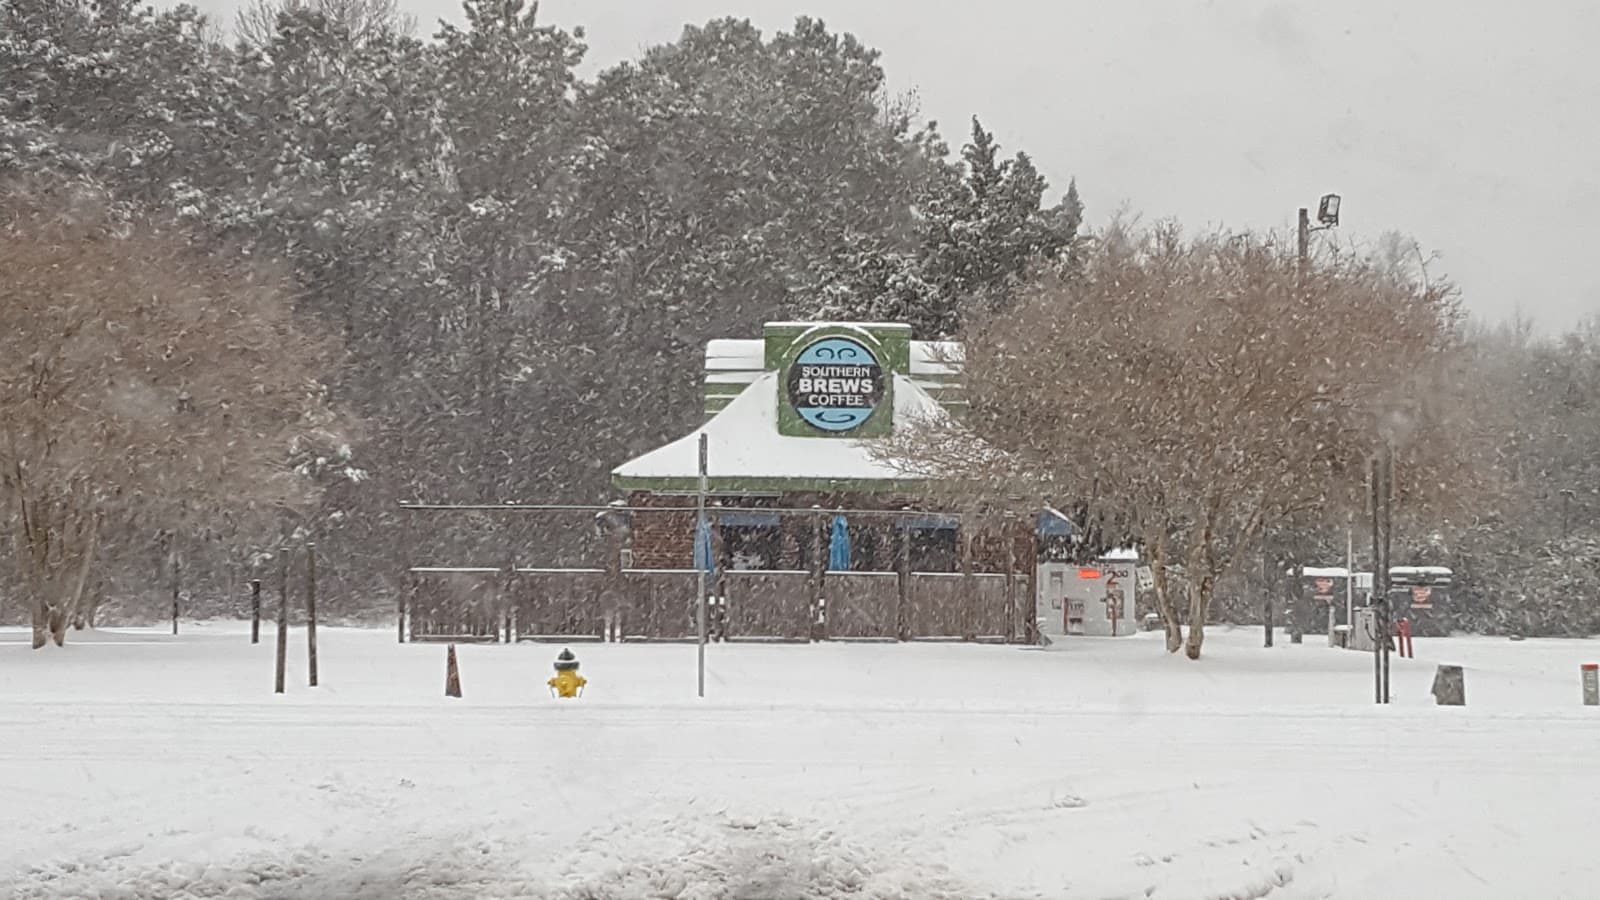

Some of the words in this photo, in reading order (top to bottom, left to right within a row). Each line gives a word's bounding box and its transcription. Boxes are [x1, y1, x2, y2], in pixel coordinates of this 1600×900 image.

[802, 366, 870, 378] SOUTHERN
[799, 378, 873, 394] BREWS
[808, 395, 864, 406] COFFEE
